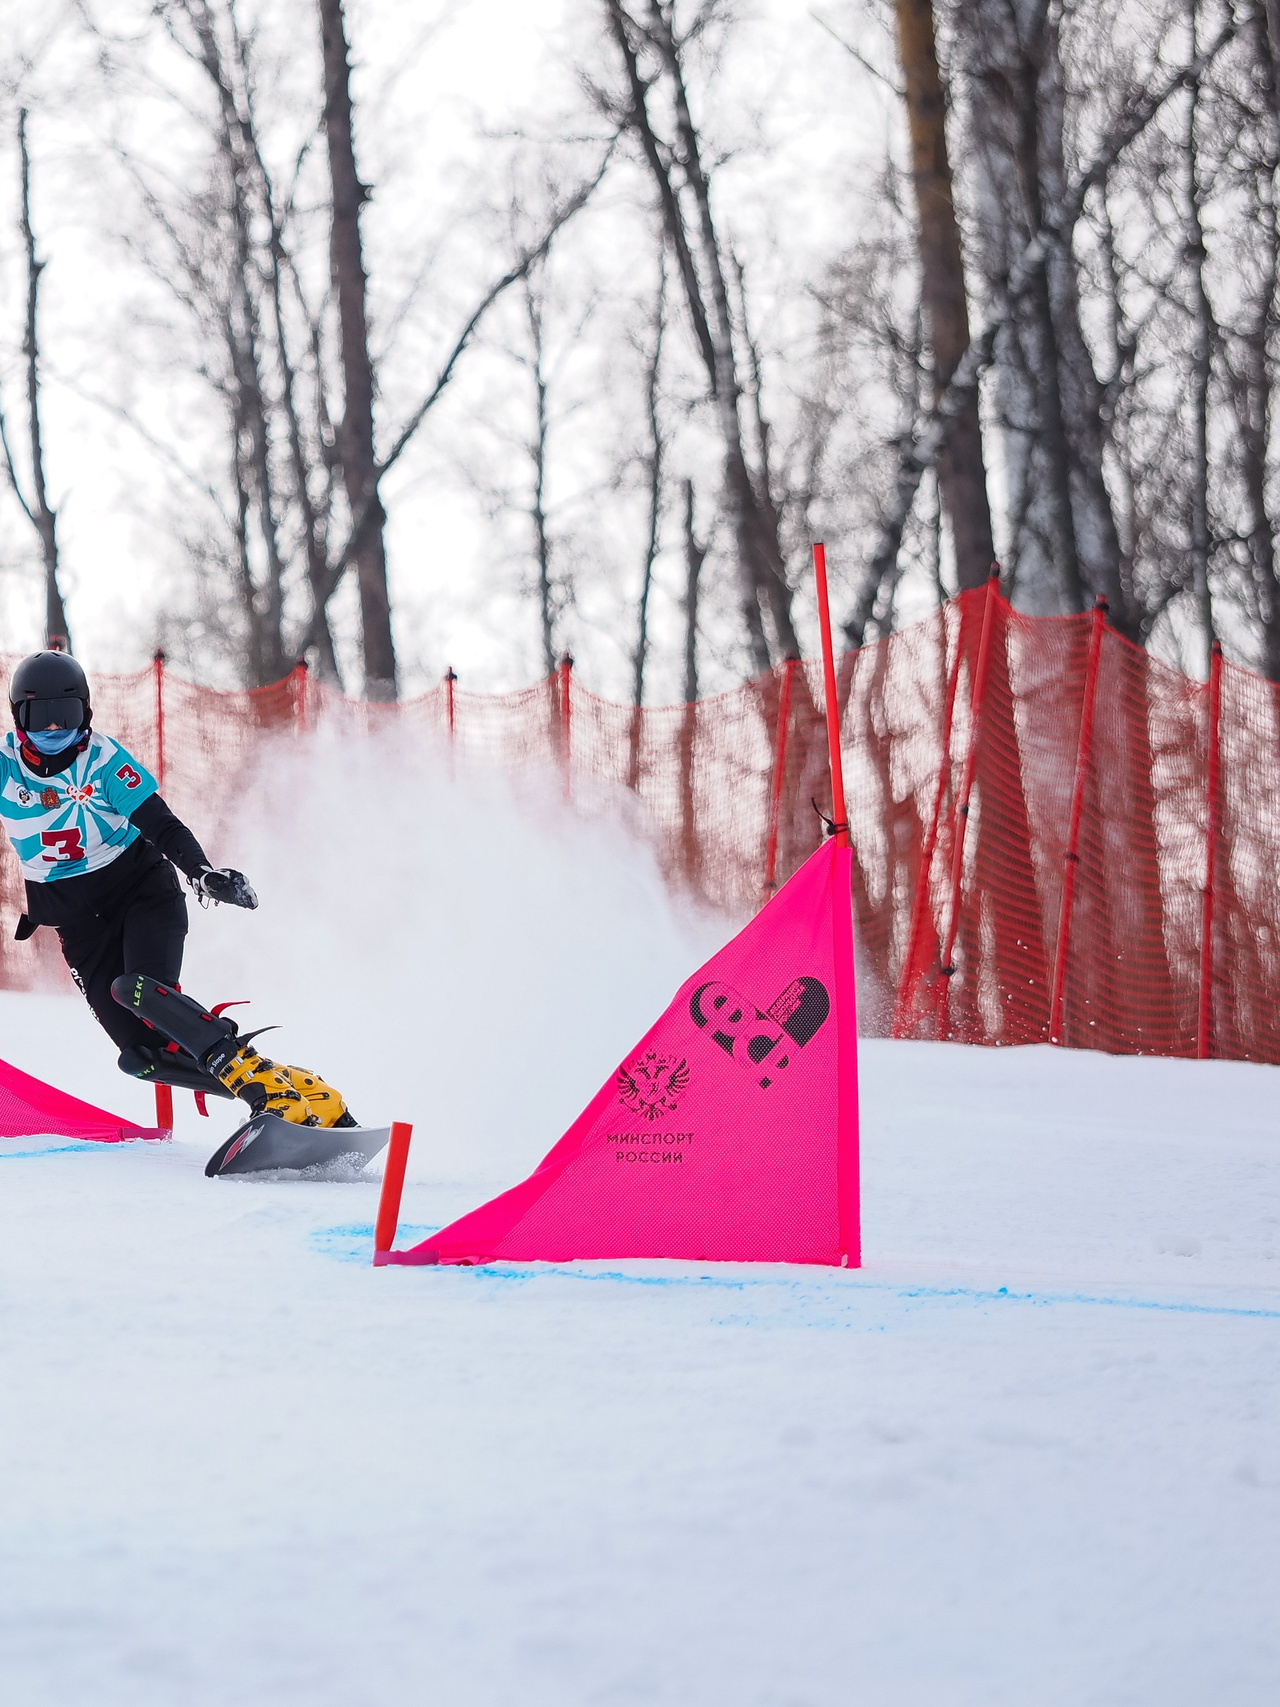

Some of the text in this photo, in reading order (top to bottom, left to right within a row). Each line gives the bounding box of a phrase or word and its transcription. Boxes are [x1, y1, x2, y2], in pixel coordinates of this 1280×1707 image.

[115, 763, 142, 789] 3
[41, 826, 86, 862] 3
[133, 975, 144, 1006] LEKI
[606, 1133, 695, 1145] МИНСПОРТ
[616, 1151, 683, 1163] РОССИИ
